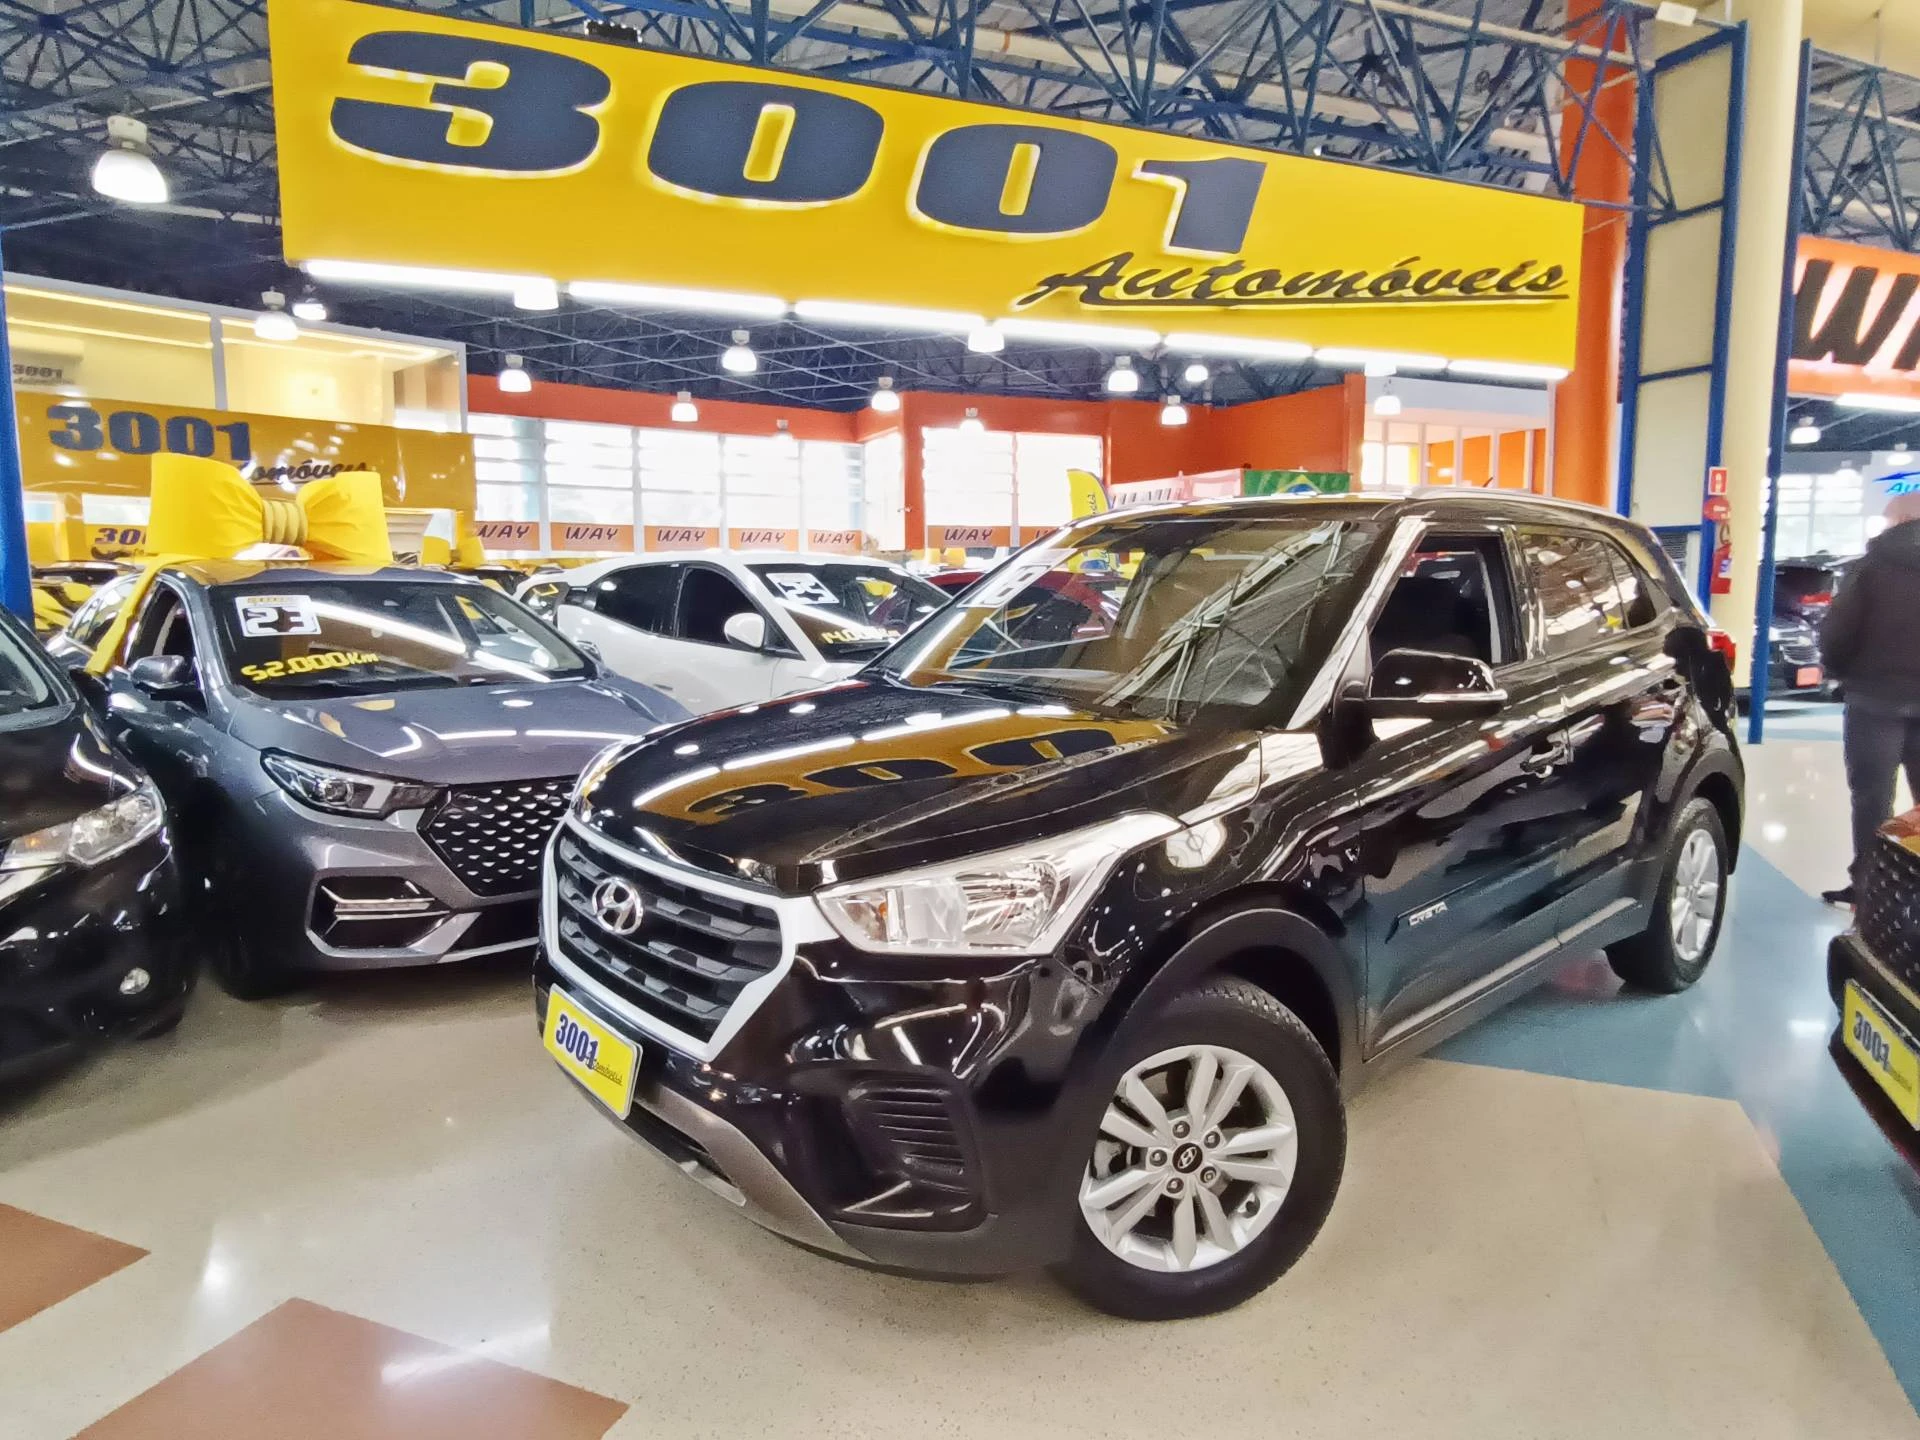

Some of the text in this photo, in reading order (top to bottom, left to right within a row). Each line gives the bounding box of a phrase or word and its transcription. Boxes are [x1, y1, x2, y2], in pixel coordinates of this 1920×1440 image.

[329, 30, 1268, 254] 3001
[1016, 250, 1571, 307] Automóveis
[1790, 258, 1920, 371] W
[46, 404, 251, 461] 3001
[95, 527, 147, 545] 30
[477, 524, 530, 539] WAY
[565, 526, 618, 540] WAY
[657, 529, 706, 543] WAY
[740, 531, 786, 544] WAY
[812, 532, 855, 544] WAY
[944, 528, 993, 541] WAY
[242, 606, 319, 633] 23
[556, 1013, 598, 1070] 3001
